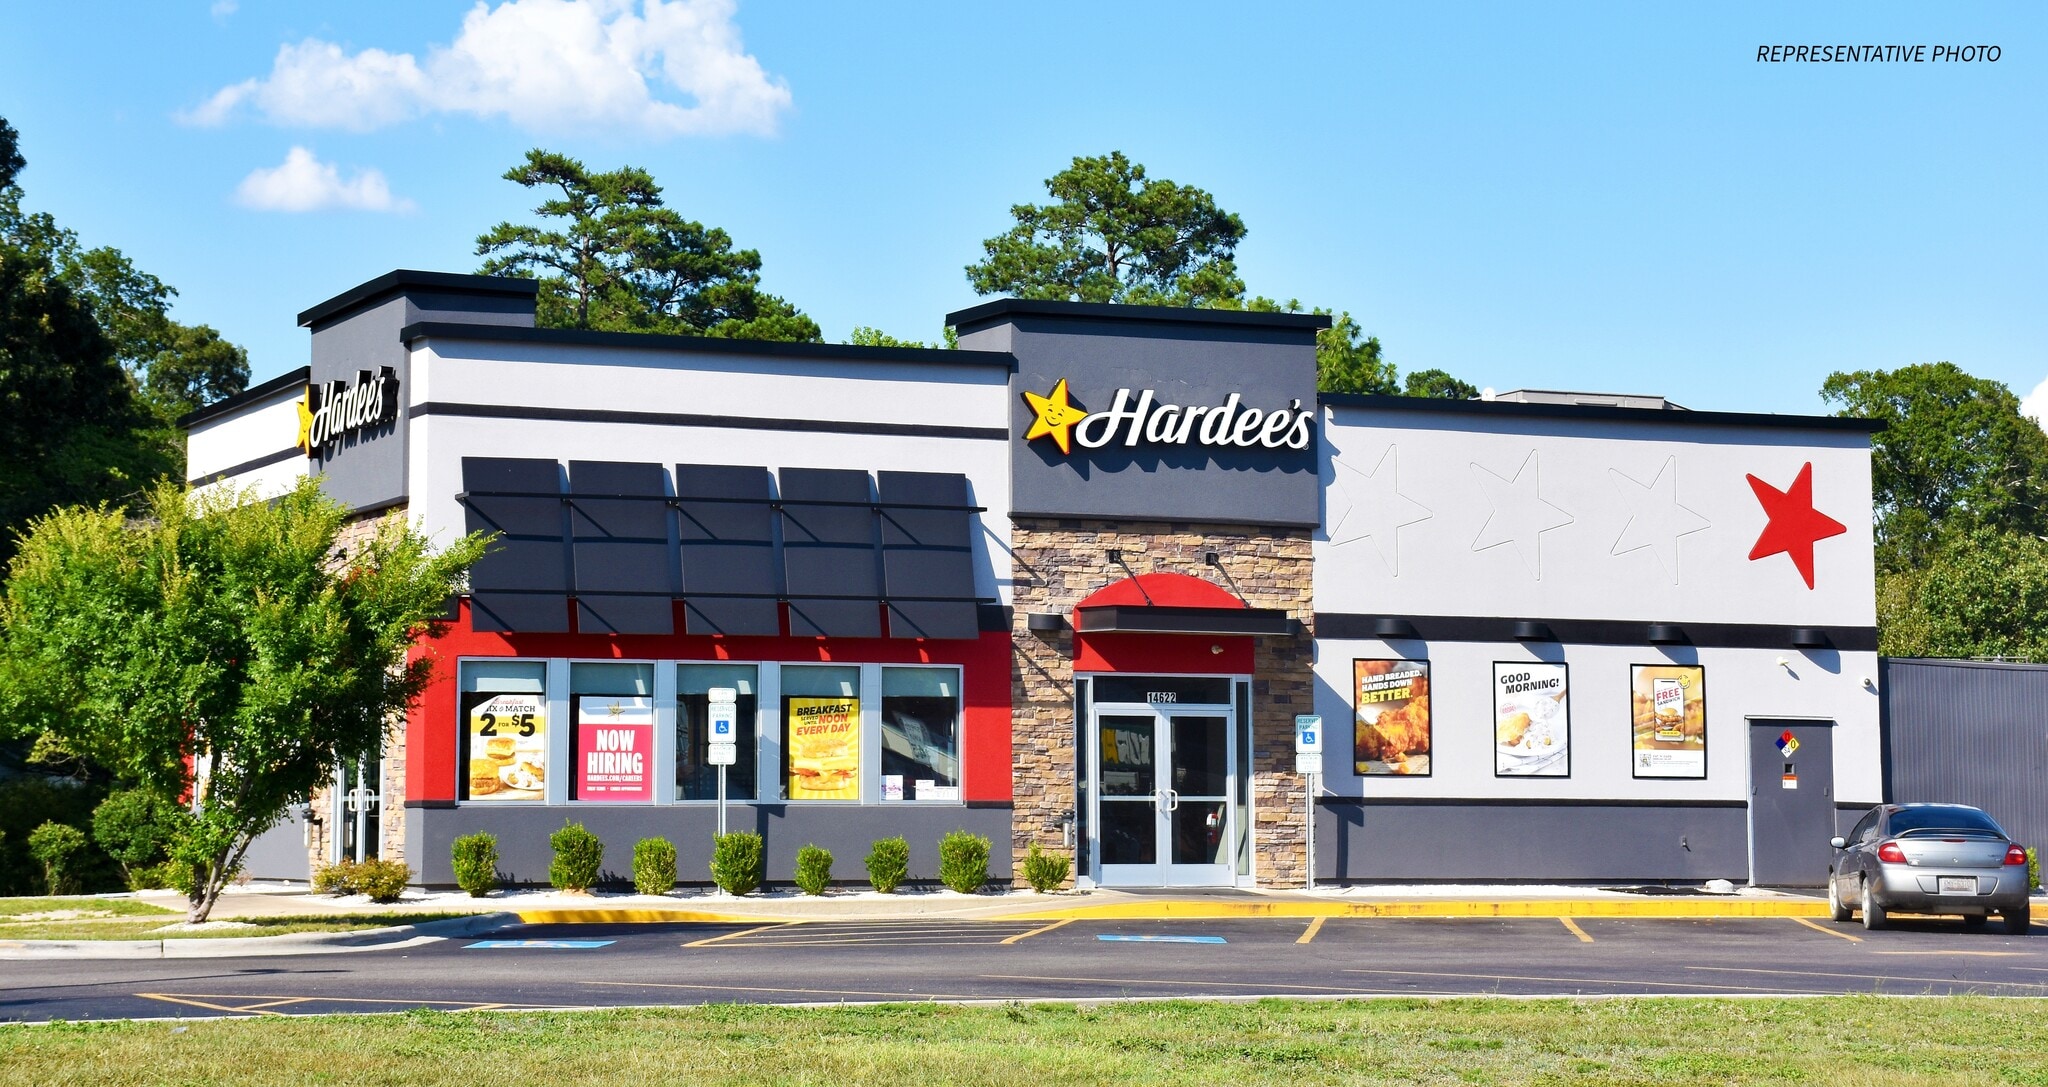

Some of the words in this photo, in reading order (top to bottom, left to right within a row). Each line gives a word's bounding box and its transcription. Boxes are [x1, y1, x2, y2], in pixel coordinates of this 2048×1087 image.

[310, 365, 386, 448] Hardee's
[1075, 388, 1314, 449] Hardee's
[1361, 674, 1384, 684] HAND
[1385, 669, 1422, 681] BREADED.
[1500, 672, 1531, 685] GOOD
[1361, 681, 1388, 692] HANDS
[1389, 678, 1413, 689] DOWN
[1505, 678, 1559, 695] MORNING!
[1147, 692, 1176, 703] 14622
[1361, 687, 1413, 704] BETTER.
[1656, 687, 1680, 702] FREE
[505, 705, 536, 713] MATCH
[796, 703, 853, 716] BREAKFAST
[480, 713, 497, 736] 2
[512, 713, 536, 737] $5
[819, 713, 849, 724] NOON
[796, 724, 829, 736] EVERY
[831, 723, 851, 733] DAY
[596, 729, 635, 751] NOW
[1790, 739, 1796, 748] 0
[587, 752, 643, 774] HIRING
